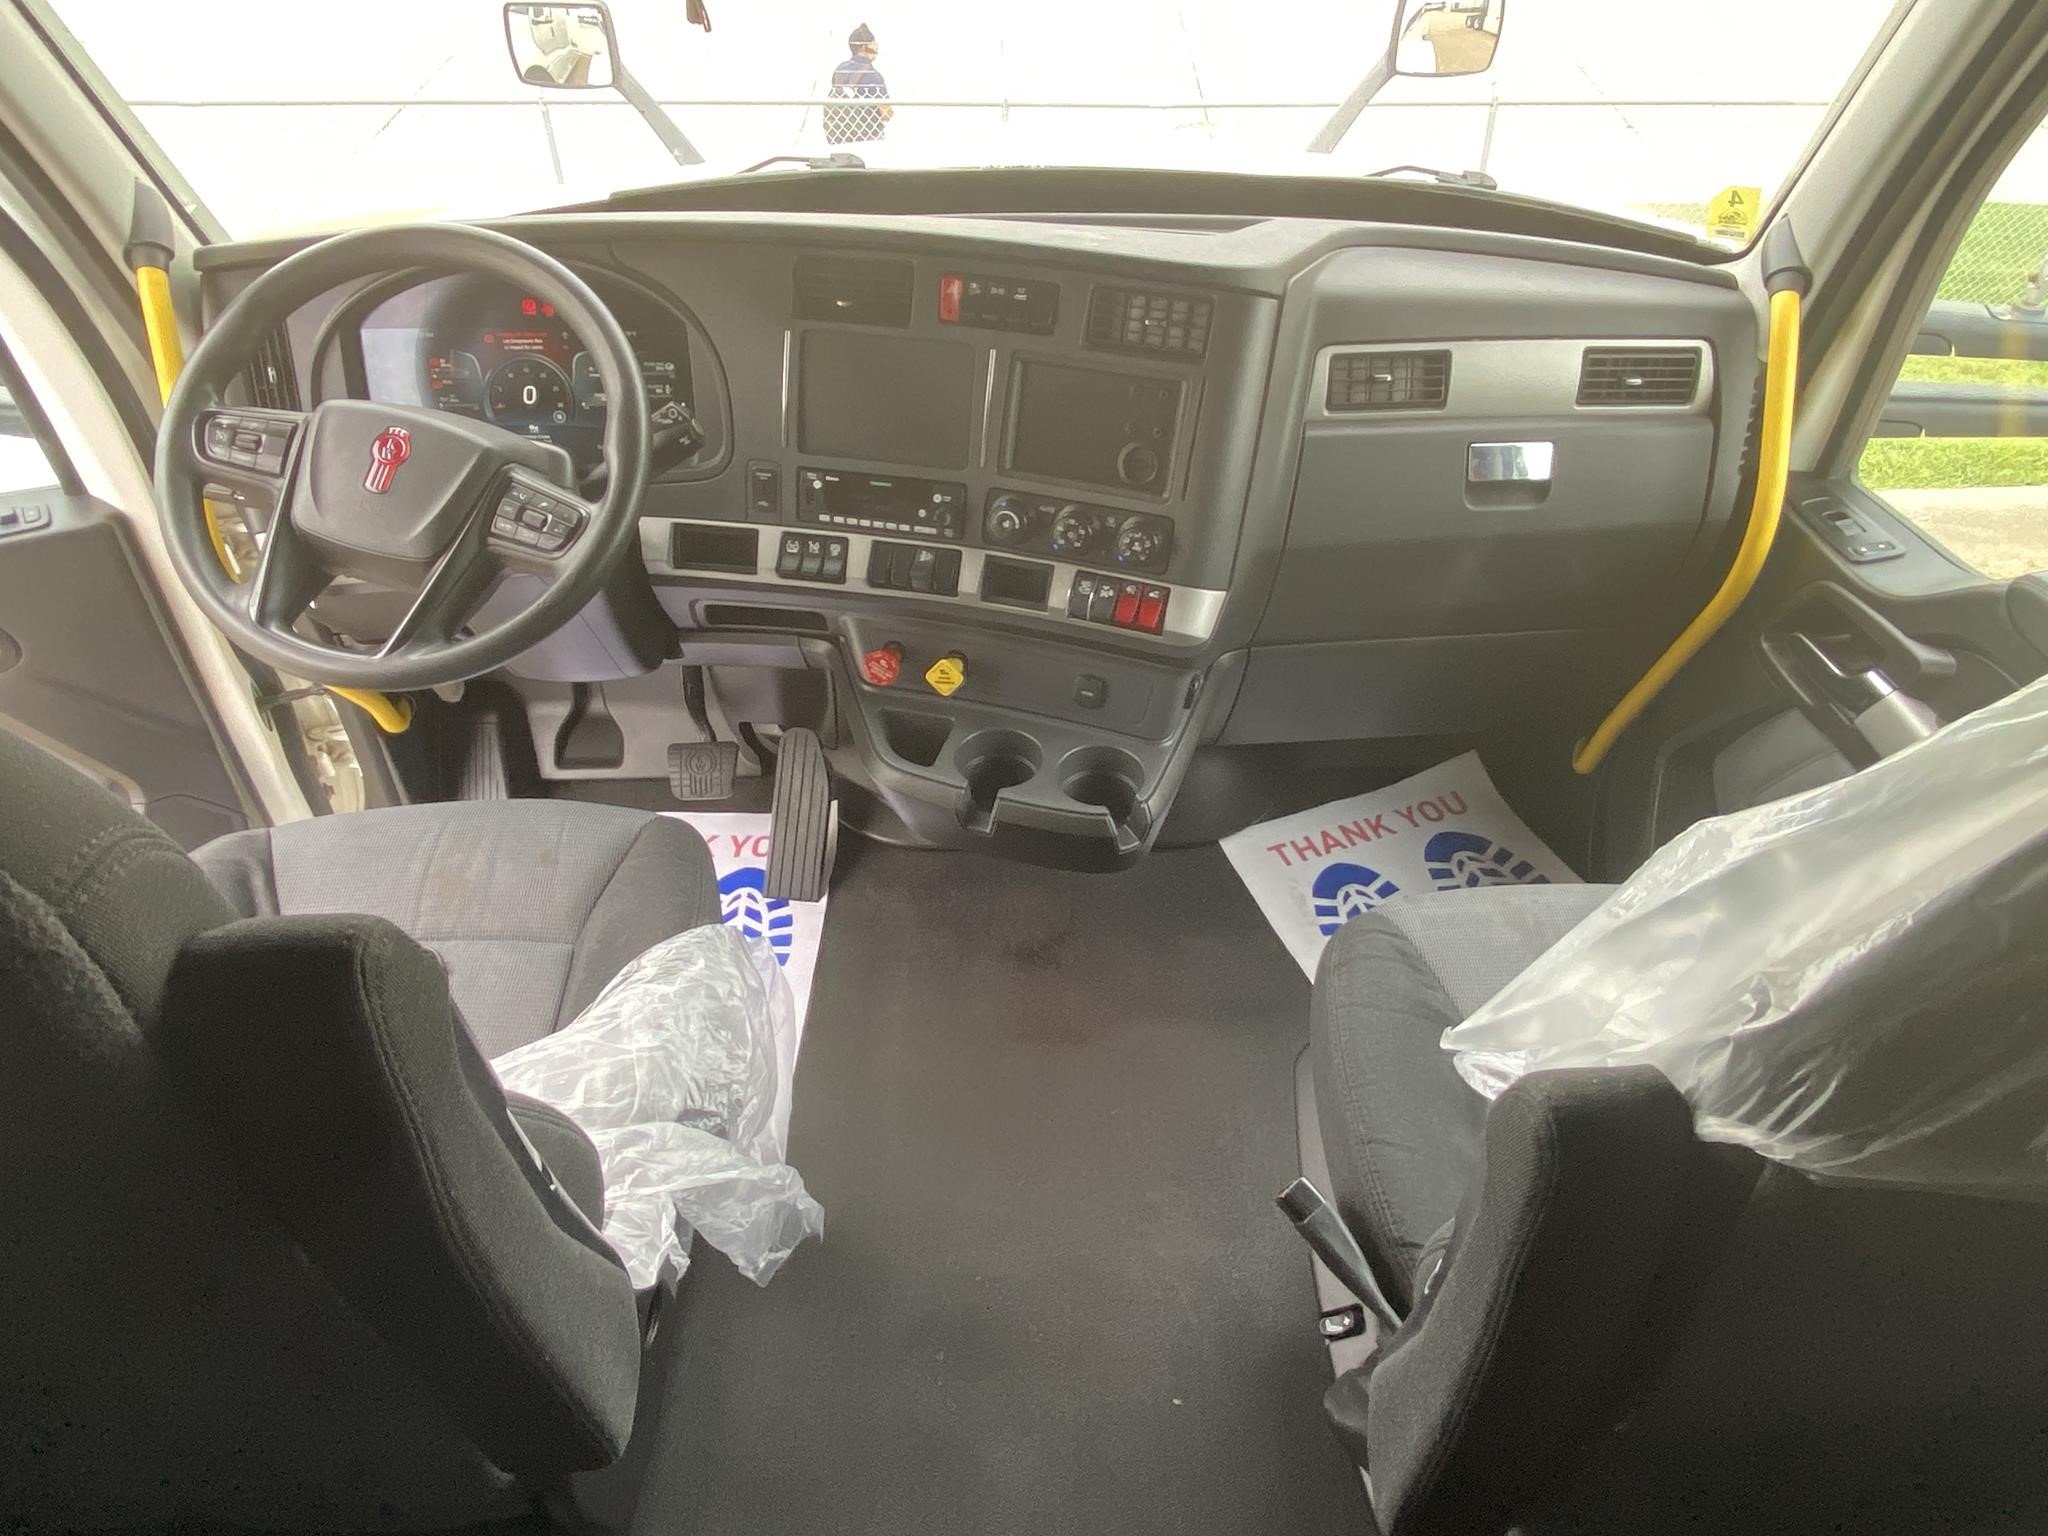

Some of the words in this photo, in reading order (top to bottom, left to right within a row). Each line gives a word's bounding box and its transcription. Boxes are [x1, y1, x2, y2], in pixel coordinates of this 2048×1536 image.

[523, 385, 537, 405] 0
[1266, 814, 1398, 866] THANK
[1393, 790, 1469, 828] YOU
[731, 835, 769, 858] YO
